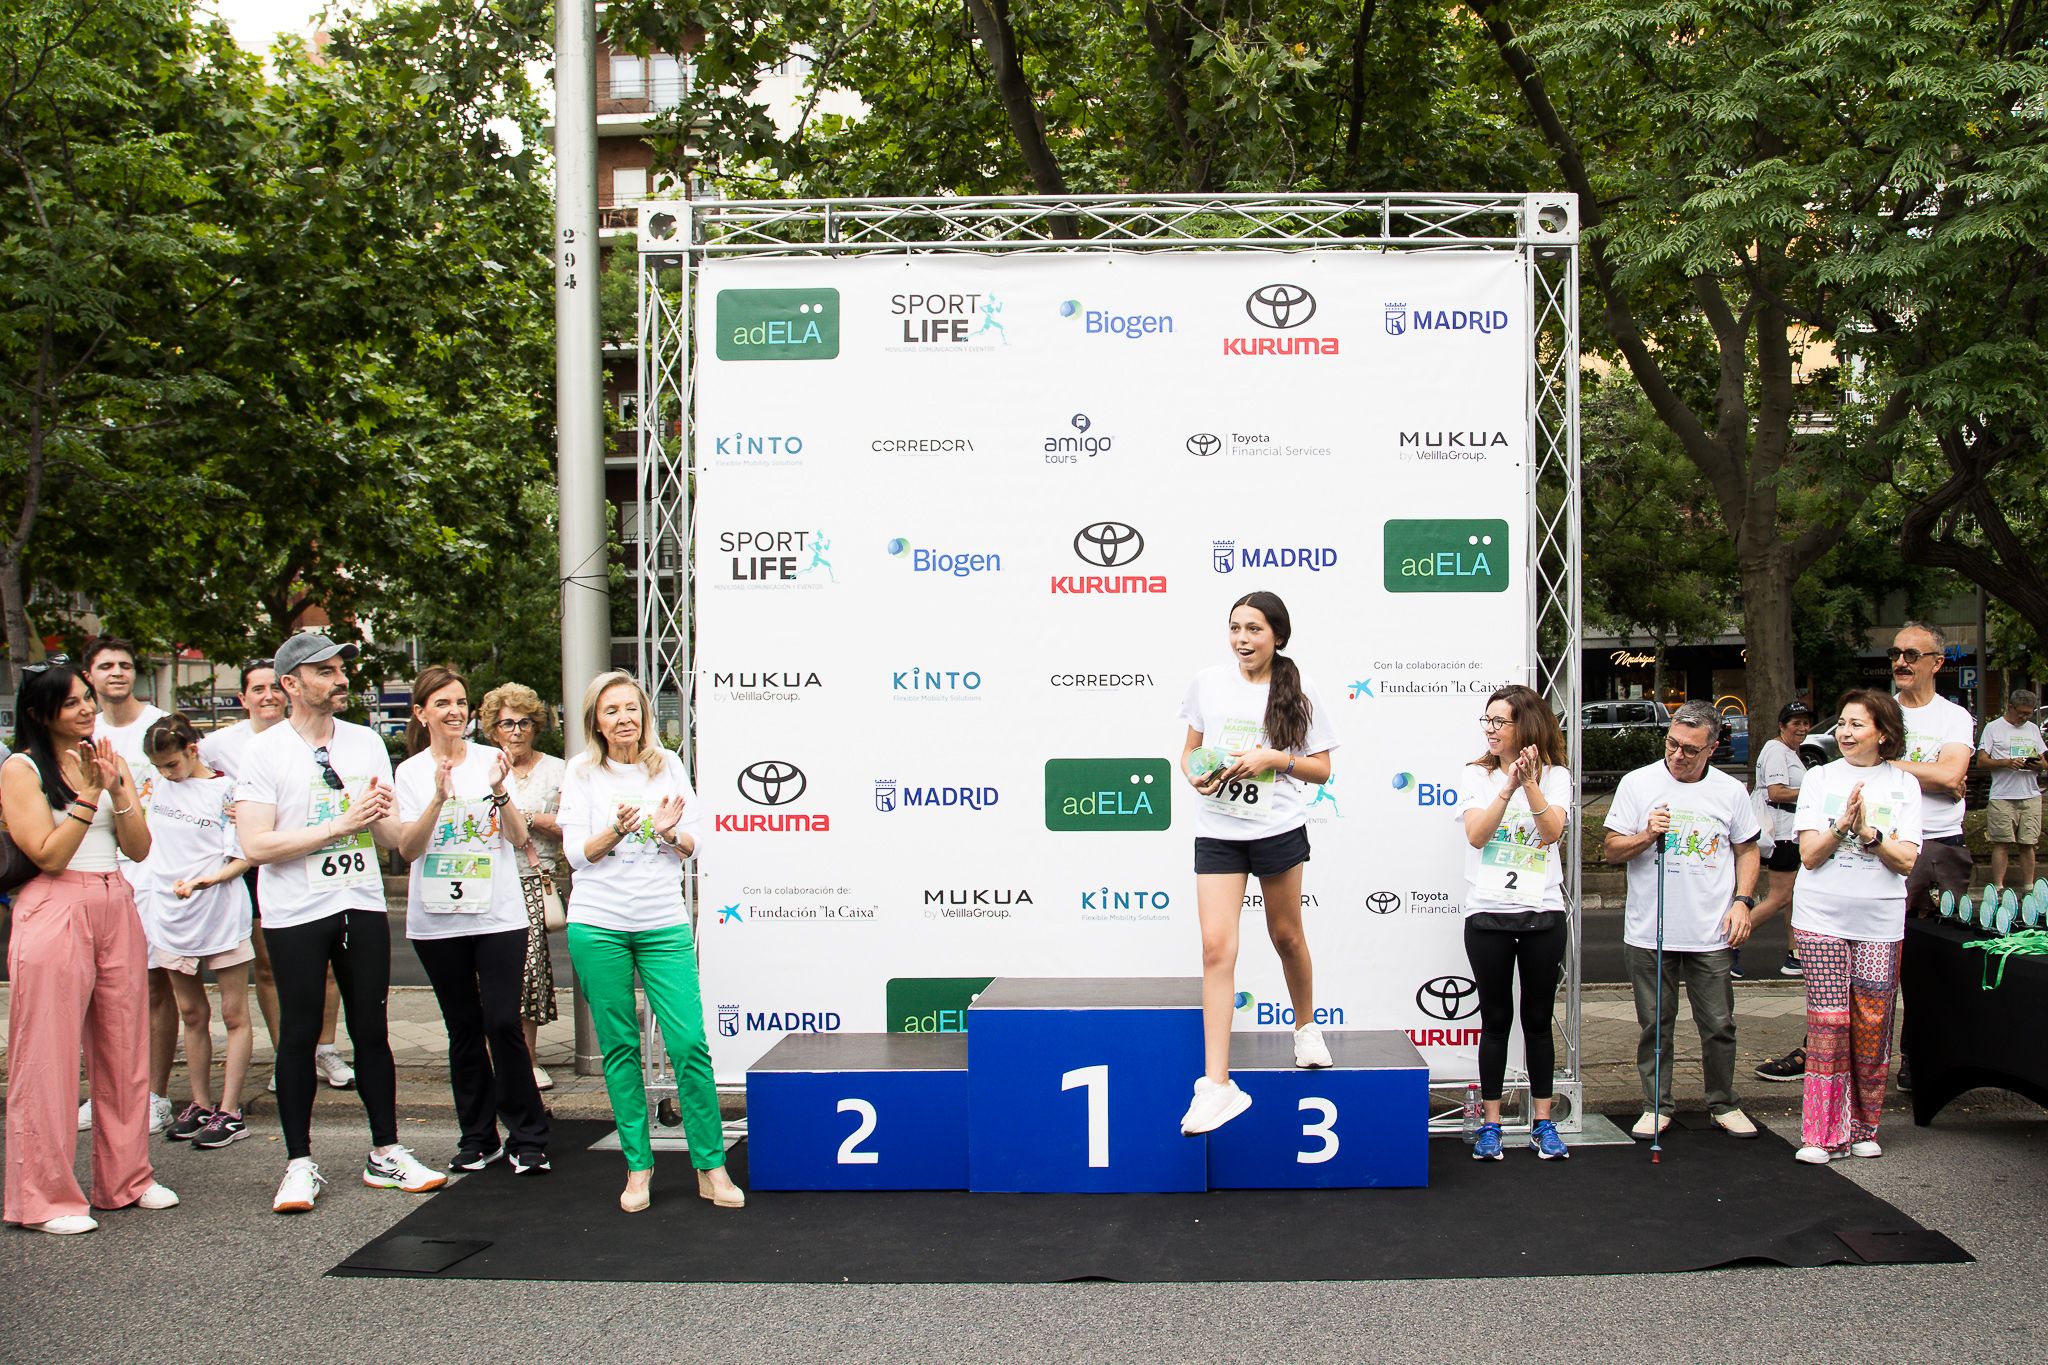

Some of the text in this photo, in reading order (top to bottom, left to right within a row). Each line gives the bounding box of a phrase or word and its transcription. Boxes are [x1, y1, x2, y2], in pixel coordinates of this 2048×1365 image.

[891, 294, 981, 314] SPORT
[733, 320, 822, 345] adELA
[904, 320, 968, 342] LIFE
[1086, 311, 1173, 339] Biogen
[1413, 310, 1508, 334] MADRID
[1044, 436, 1112, 458] amigo
[1232, 433, 1270, 444] Toyota
[1400, 431, 1508, 447] MUKUA
[1045, 454, 1078, 464] tours
[1232, 446, 1331, 456] Financial Services
[1400, 449, 1487, 462] by VelillaGroup.
[719, 531, 809, 552] SPORT
[732, 556, 797, 580] LIFE
[913, 549, 1001, 577] Biogen
[1242, 548, 1338, 571] MADRID
[1401, 552, 1492, 577] adELA
[1374, 661, 1484, 670] Con la colaboración de:
[714, 672, 823, 688] MUKUA
[1380, 681, 1448, 693] Fundación
[1963, 669, 1976, 685] P
[714, 690, 801, 702] by VelillaGroup.
[904, 787, 999, 810] MADRID
[1062, 791, 1153, 815] adELA
[1418, 783, 1458, 806] Bio
[321, 852, 365, 877] 698
[450, 881, 464, 900] 3
[742, 886, 852, 895] Con la colaboración de:
[1504, 871, 1518, 890] 2
[924, 889, 1034, 905] MUKUA
[1411, 891, 1449, 902] Toyota
[749, 905, 817, 918] Fundación
[924, 908, 1012, 920] by VelillaGroup.
[1411, 903, 1461, 914] Financial
[746, 1012, 841, 1033] MADRID
[904, 1009, 968, 1033] adEL
[1257, 1002, 1344, 1026] Bioen
[1061, 1064, 1110, 1168] 1
[836, 1098, 879, 1164] 2
[1296, 1096, 1340, 1164] 3
